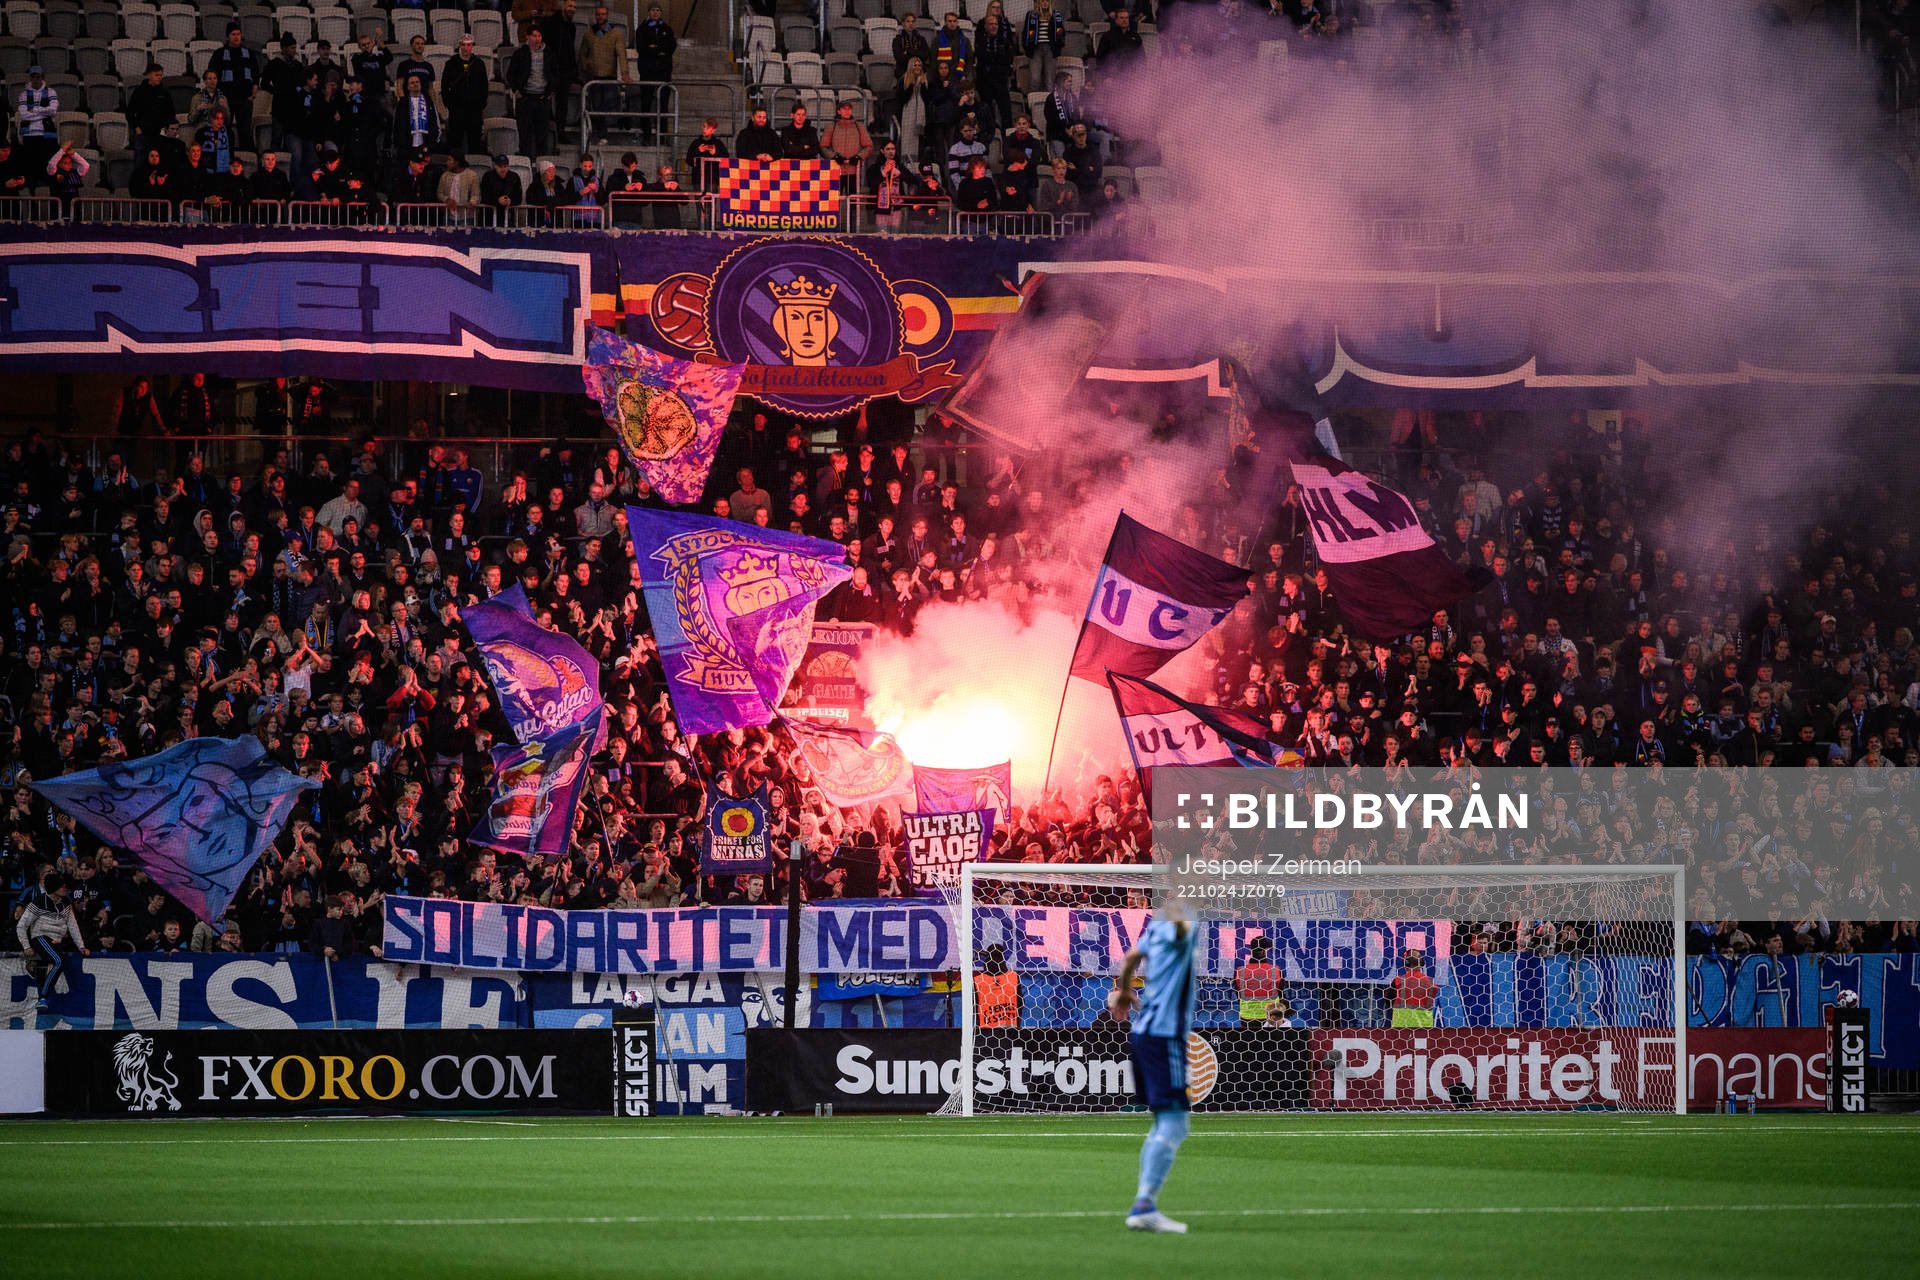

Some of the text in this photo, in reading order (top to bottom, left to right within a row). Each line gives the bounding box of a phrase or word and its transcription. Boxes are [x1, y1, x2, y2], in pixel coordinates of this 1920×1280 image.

[904, 811, 981, 839] ULTRA
[909, 832, 979, 866] CAOS
[383, 898, 789, 973] SOLIDARITET
[817, 908, 948, 970] MED
[198, 1054, 558, 1101] FXORO.COM
[624, 1027, 649, 1117] SELECT
[1332, 1037, 1621, 1102] Prioritet
[1841, 1022, 1865, 1112] SELECT
